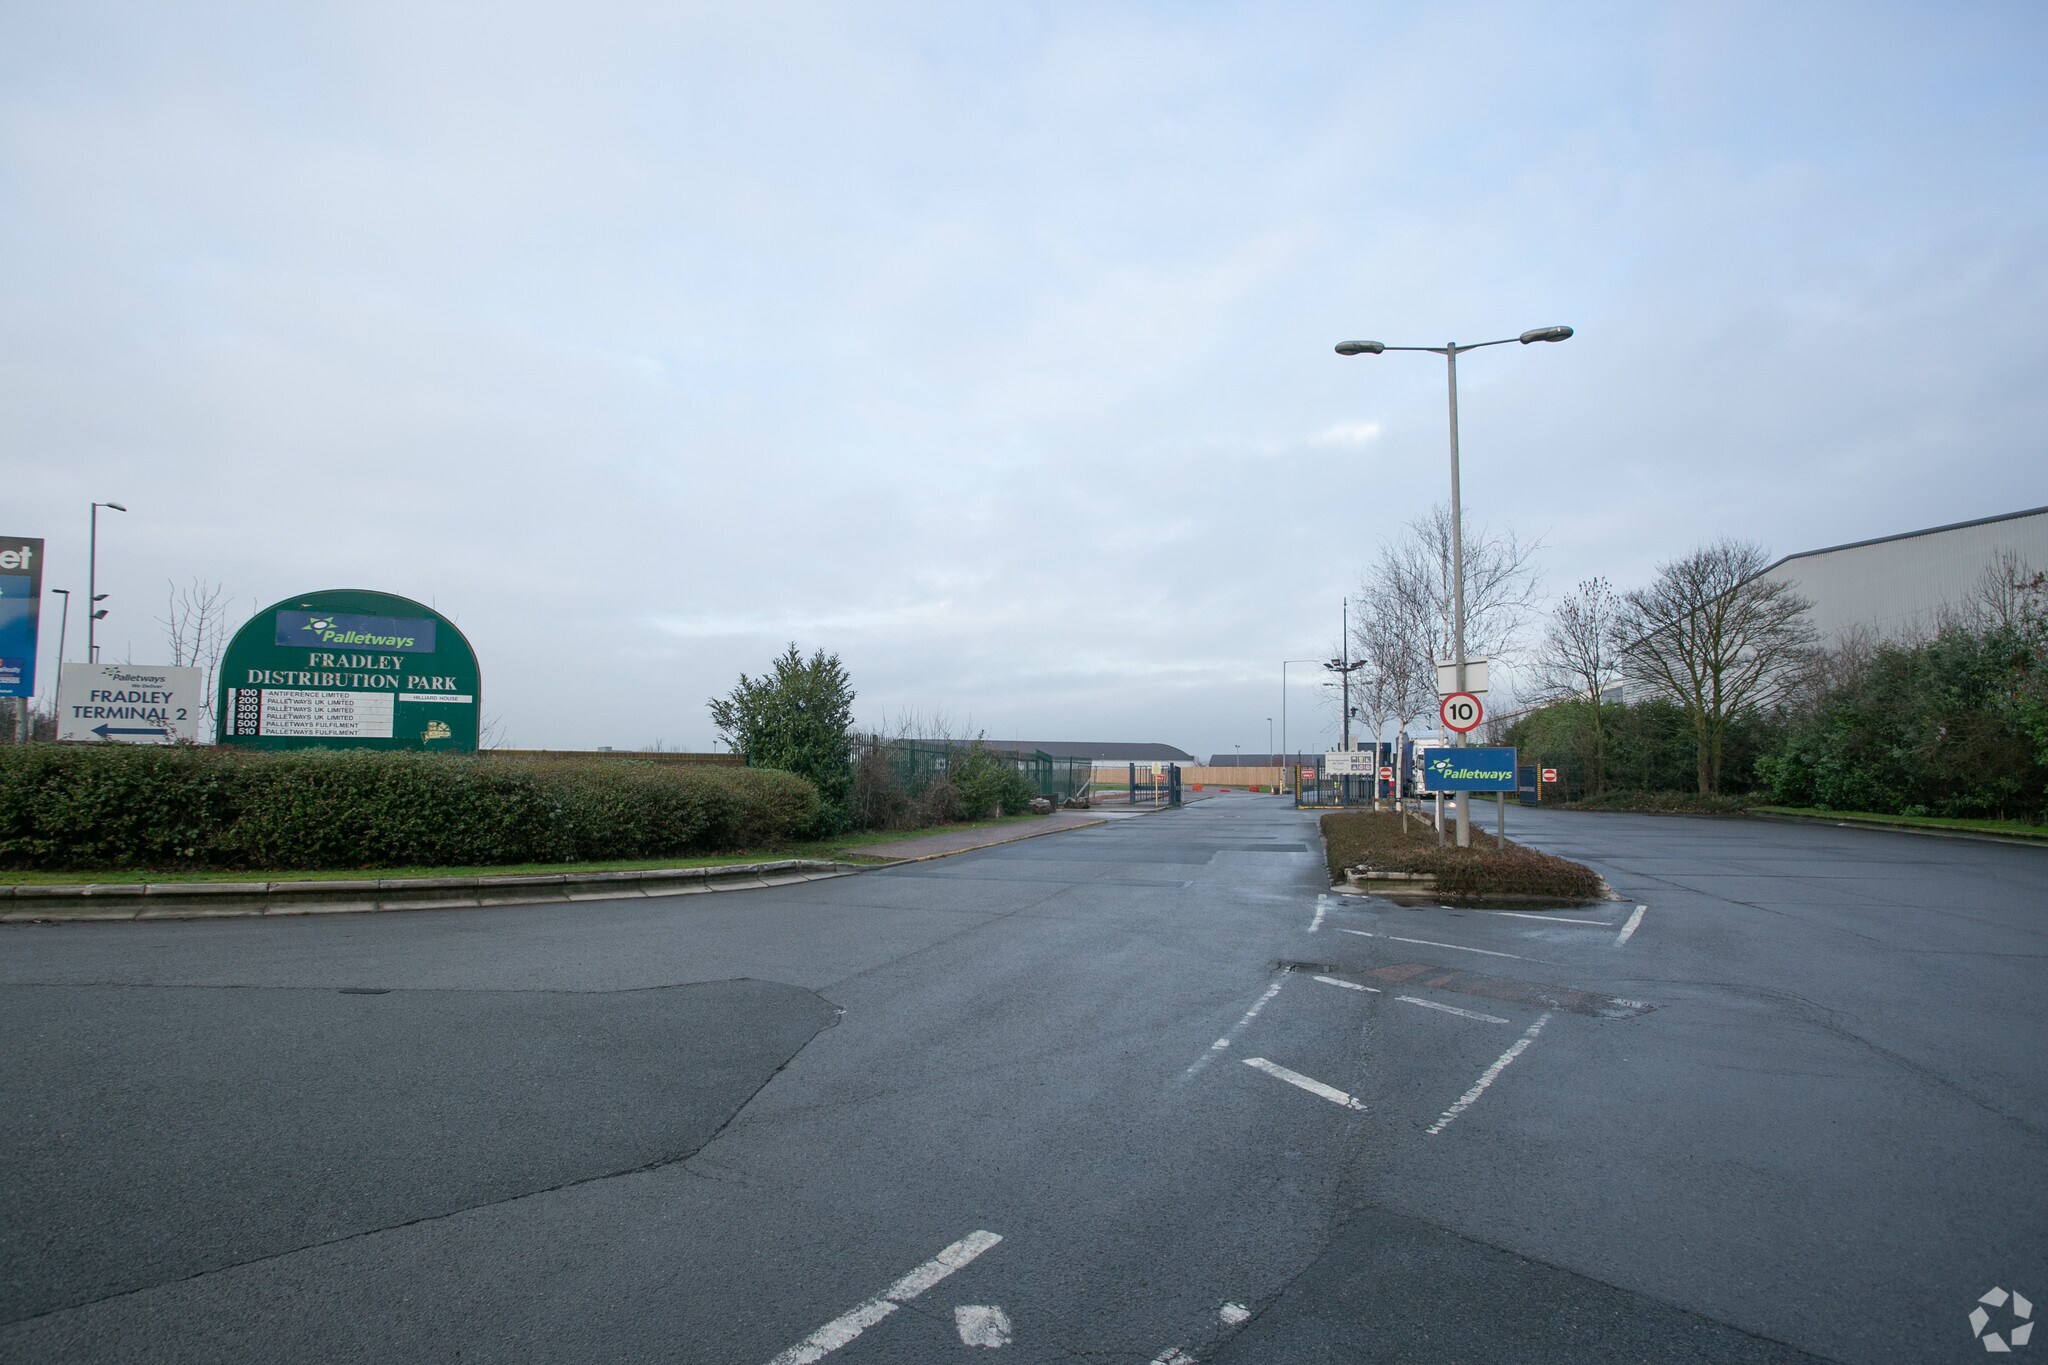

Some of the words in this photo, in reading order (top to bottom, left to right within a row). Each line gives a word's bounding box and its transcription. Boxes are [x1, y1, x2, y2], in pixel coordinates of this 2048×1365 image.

[322, 630, 414, 648] Palletways
[309, 653, 405, 670] FRADLEY
[112, 673, 166, 683] Palletways
[247, 669, 400, 689] DISTRIBUTION
[407, 676, 458, 691] PARK
[90, 690, 174, 704] FRADLEY
[72, 706, 170, 720] TERMINAL
[176, 708, 188, 720] 2
[1449, 703, 1473, 720] 10
[1443, 768, 1513, 781] Palletways
